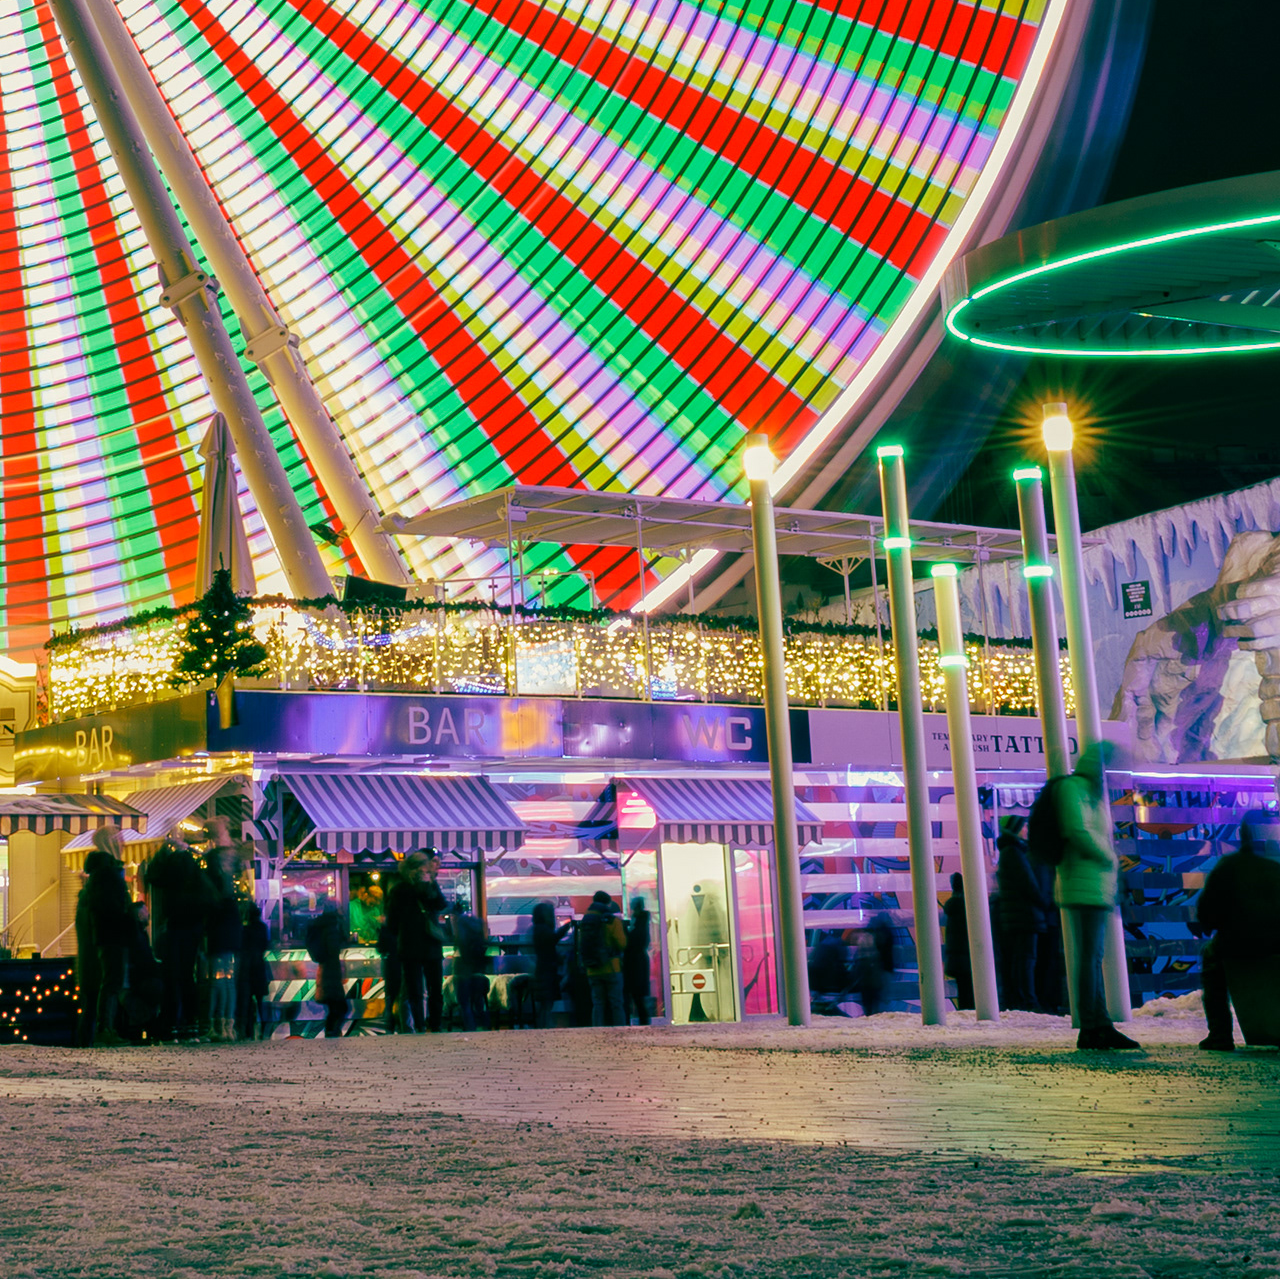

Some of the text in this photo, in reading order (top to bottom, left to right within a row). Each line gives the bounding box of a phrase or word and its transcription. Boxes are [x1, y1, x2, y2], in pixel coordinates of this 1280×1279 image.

[76, 725, 114, 767] BAR
[408, 706, 752, 751] BAR WC
[990, 735, 1078, 755] TATTO
